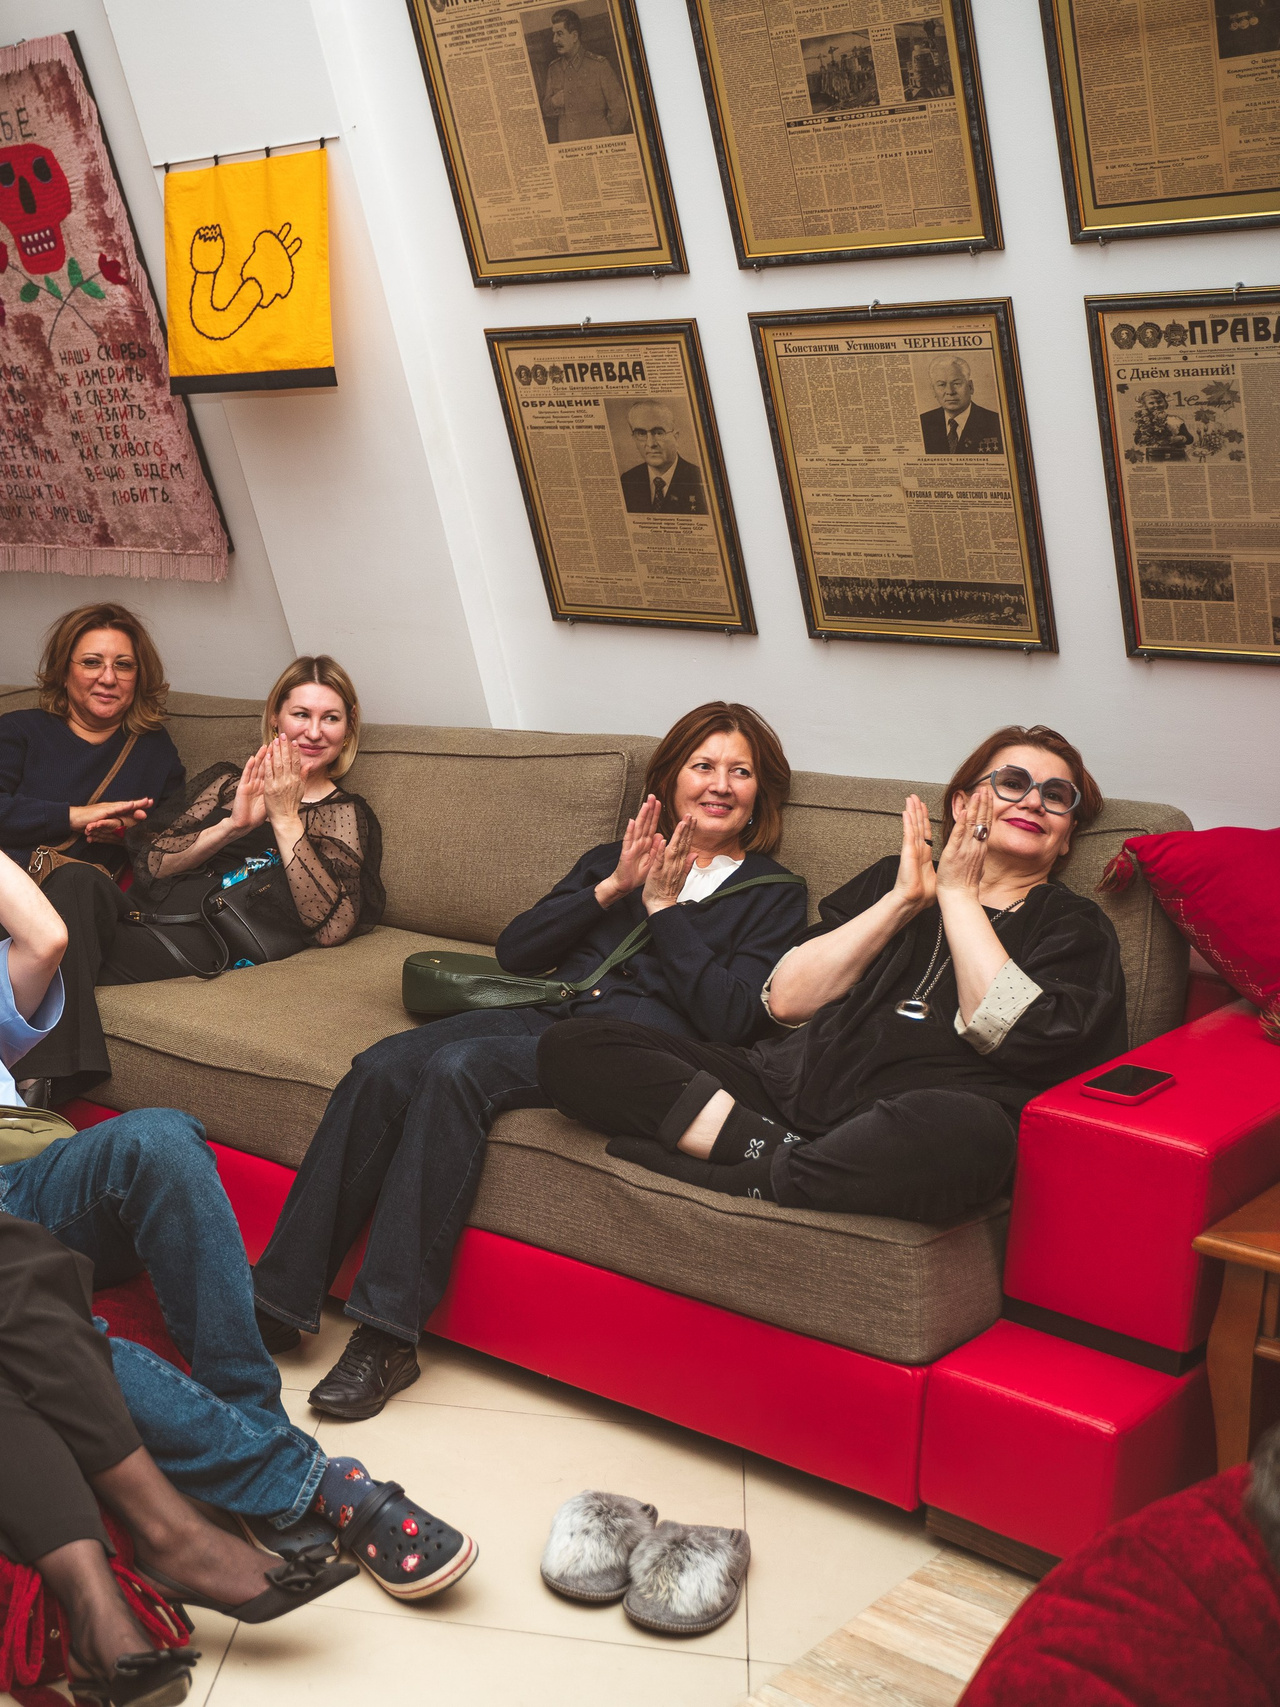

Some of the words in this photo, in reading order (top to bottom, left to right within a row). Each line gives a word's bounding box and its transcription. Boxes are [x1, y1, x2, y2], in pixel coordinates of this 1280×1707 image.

[802, 117, 829, 126] мир
[834, 109, 890, 122] сегодня
[783, 342, 840, 354] Константин
[844, 340, 897, 352] Устинович
[902, 335, 983, 350] ЧЕРНЕНКО
[59, 347, 91, 366] НАШУ
[97, 341, 147, 362] СКОРБЬ
[56, 372, 71, 388] НЕ
[563, 361, 646, 383] ПРАВДА
[1116, 368, 1127, 380] С
[1130, 366, 1170, 381] Днём
[1173, 364, 1236, 378] знаний!
[73, 391, 82, 406] В
[86, 386, 131, 407] СЛЕЗАХ
[521, 399, 601, 409] ОБРАЩЕНИЕ
[1173, 390, 1186, 407] 1
[7, 407, 44, 424] ГОРЮ
[70, 409, 86, 425] НЕ
[71, 430, 93, 447] МЫ
[0, 445, 17, 461] НЕТ
[22, 446, 30, 461] С
[79, 444, 102, 464] КАК
[84, 465, 126, 483] ВЕЧНО
[133, 462, 185, 480] БУДЕМ
[44, 483, 66, 501] ТЫ
[111, 486, 173, 506] ЛЮБИТЬ.
[905, 490, 932, 499] ГЛУБОКАЯ
[934, 491, 954, 499] СКОРБЬ
[956, 491, 988, 499] СОВЕТСКОГО
[990, 491, 1012, 500] НАРОДА
[28, 505, 44, 521] НЕ
